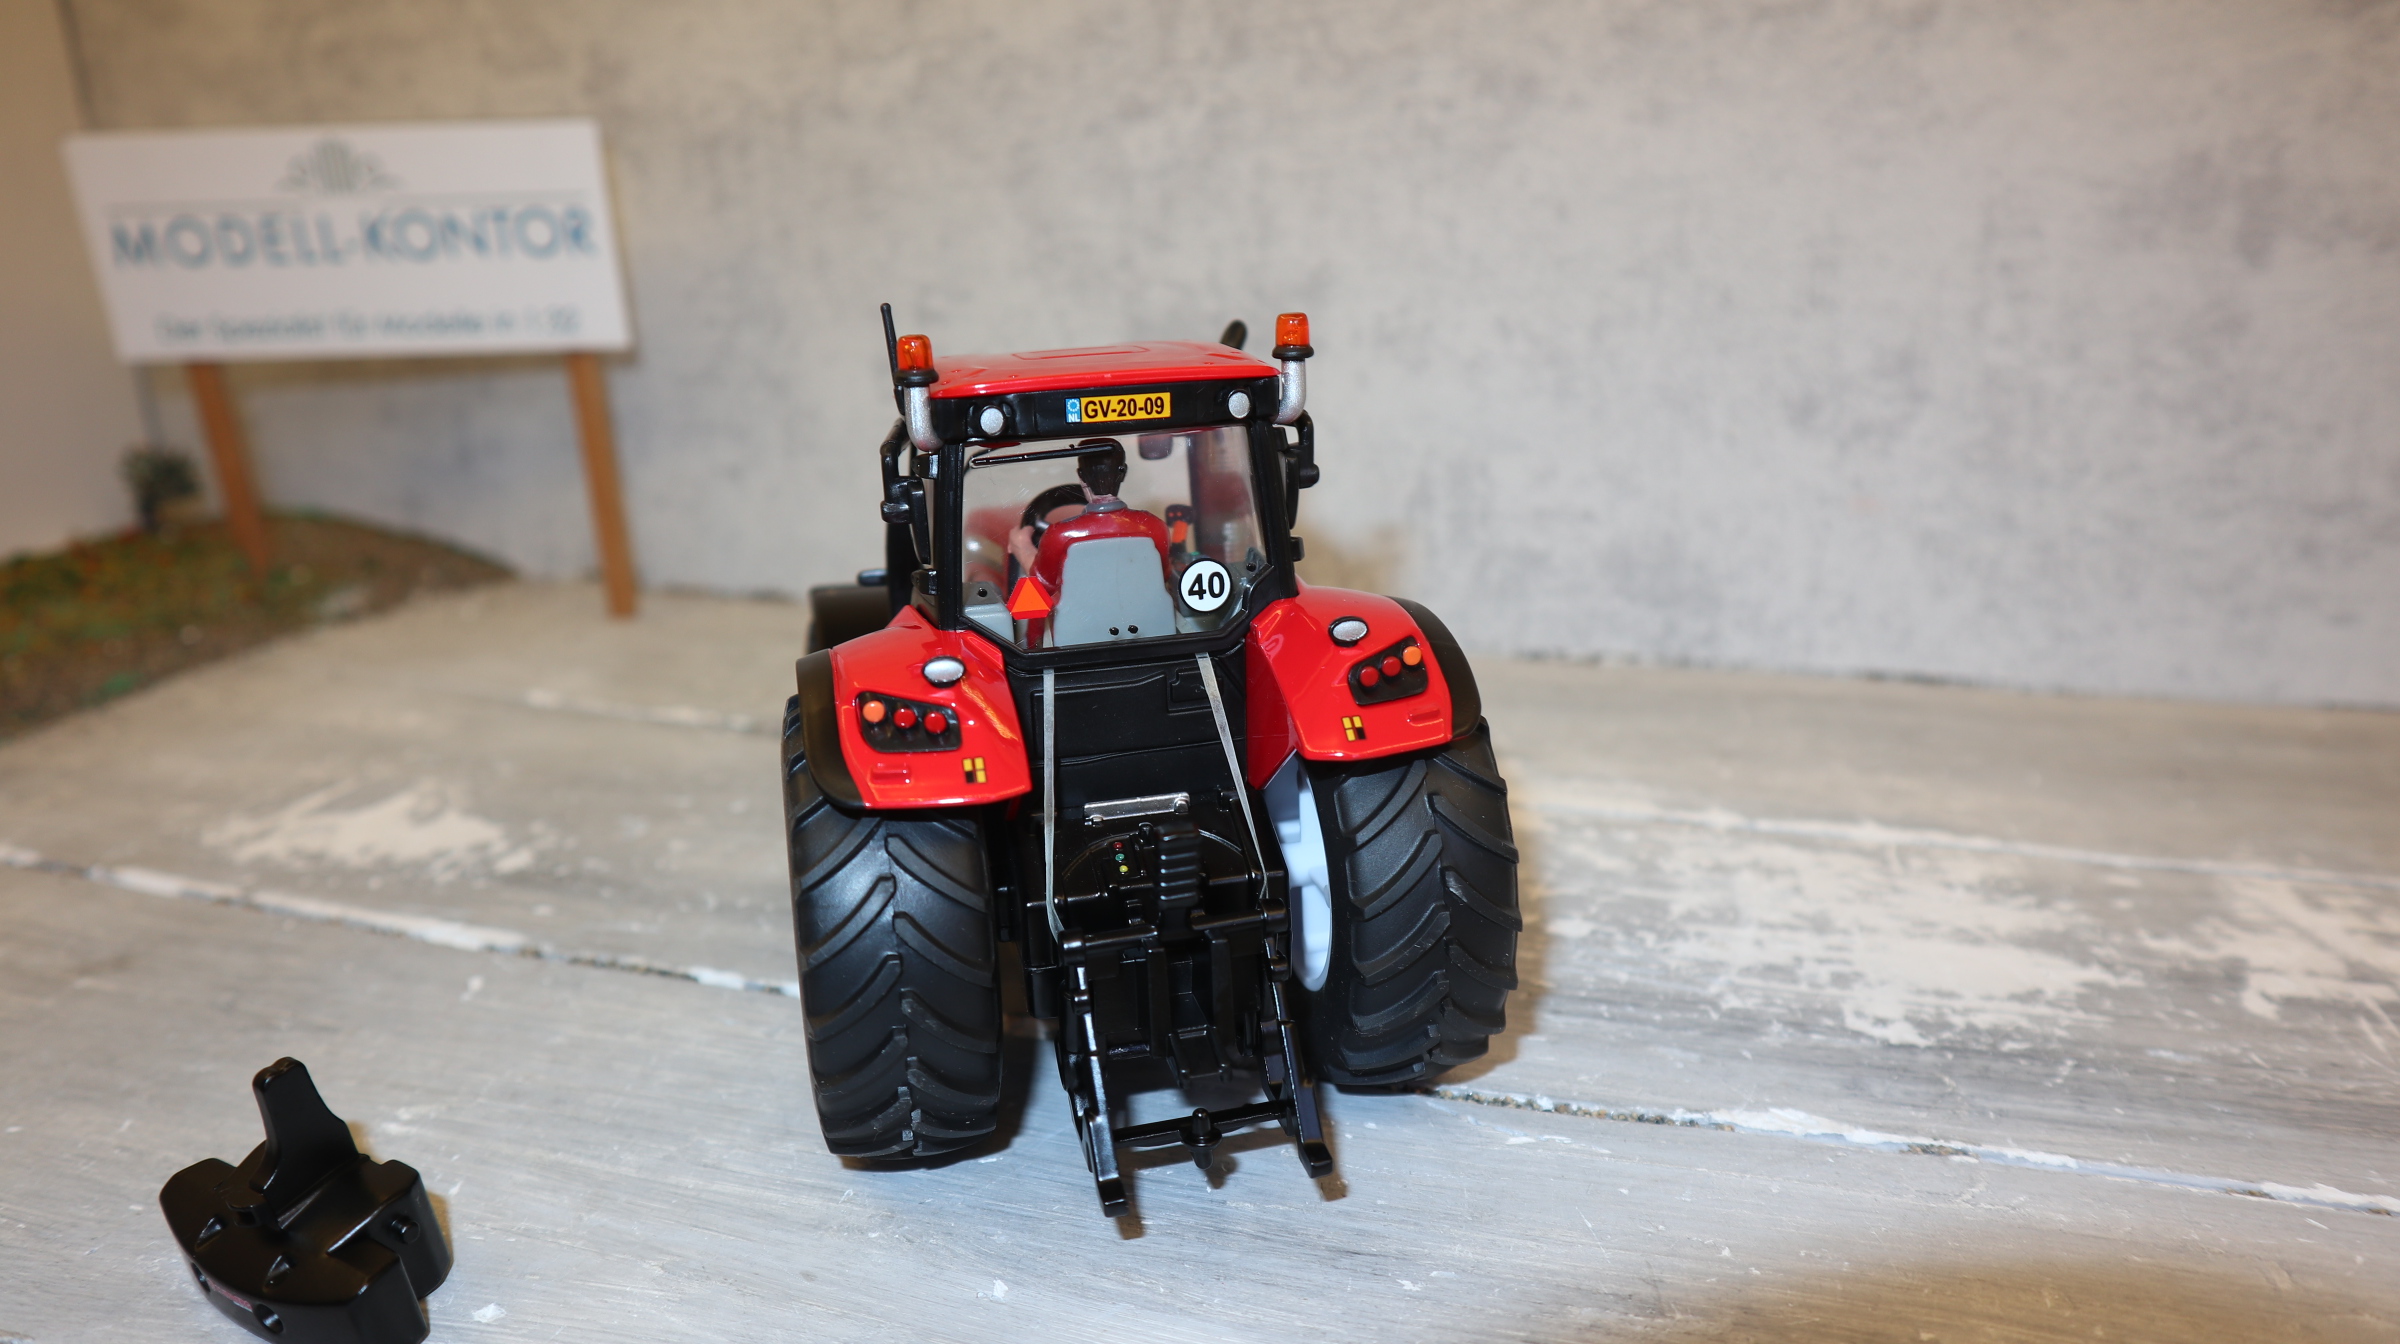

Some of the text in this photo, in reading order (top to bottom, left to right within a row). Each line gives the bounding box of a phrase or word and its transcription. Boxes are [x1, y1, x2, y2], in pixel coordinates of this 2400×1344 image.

[112, 205, 597, 268] MODELL-KONTOR
[1068, 413, 1080, 422] NL
[1084, 396, 1165, 419] GV-20-09
[1187, 571, 1225, 600] 40
